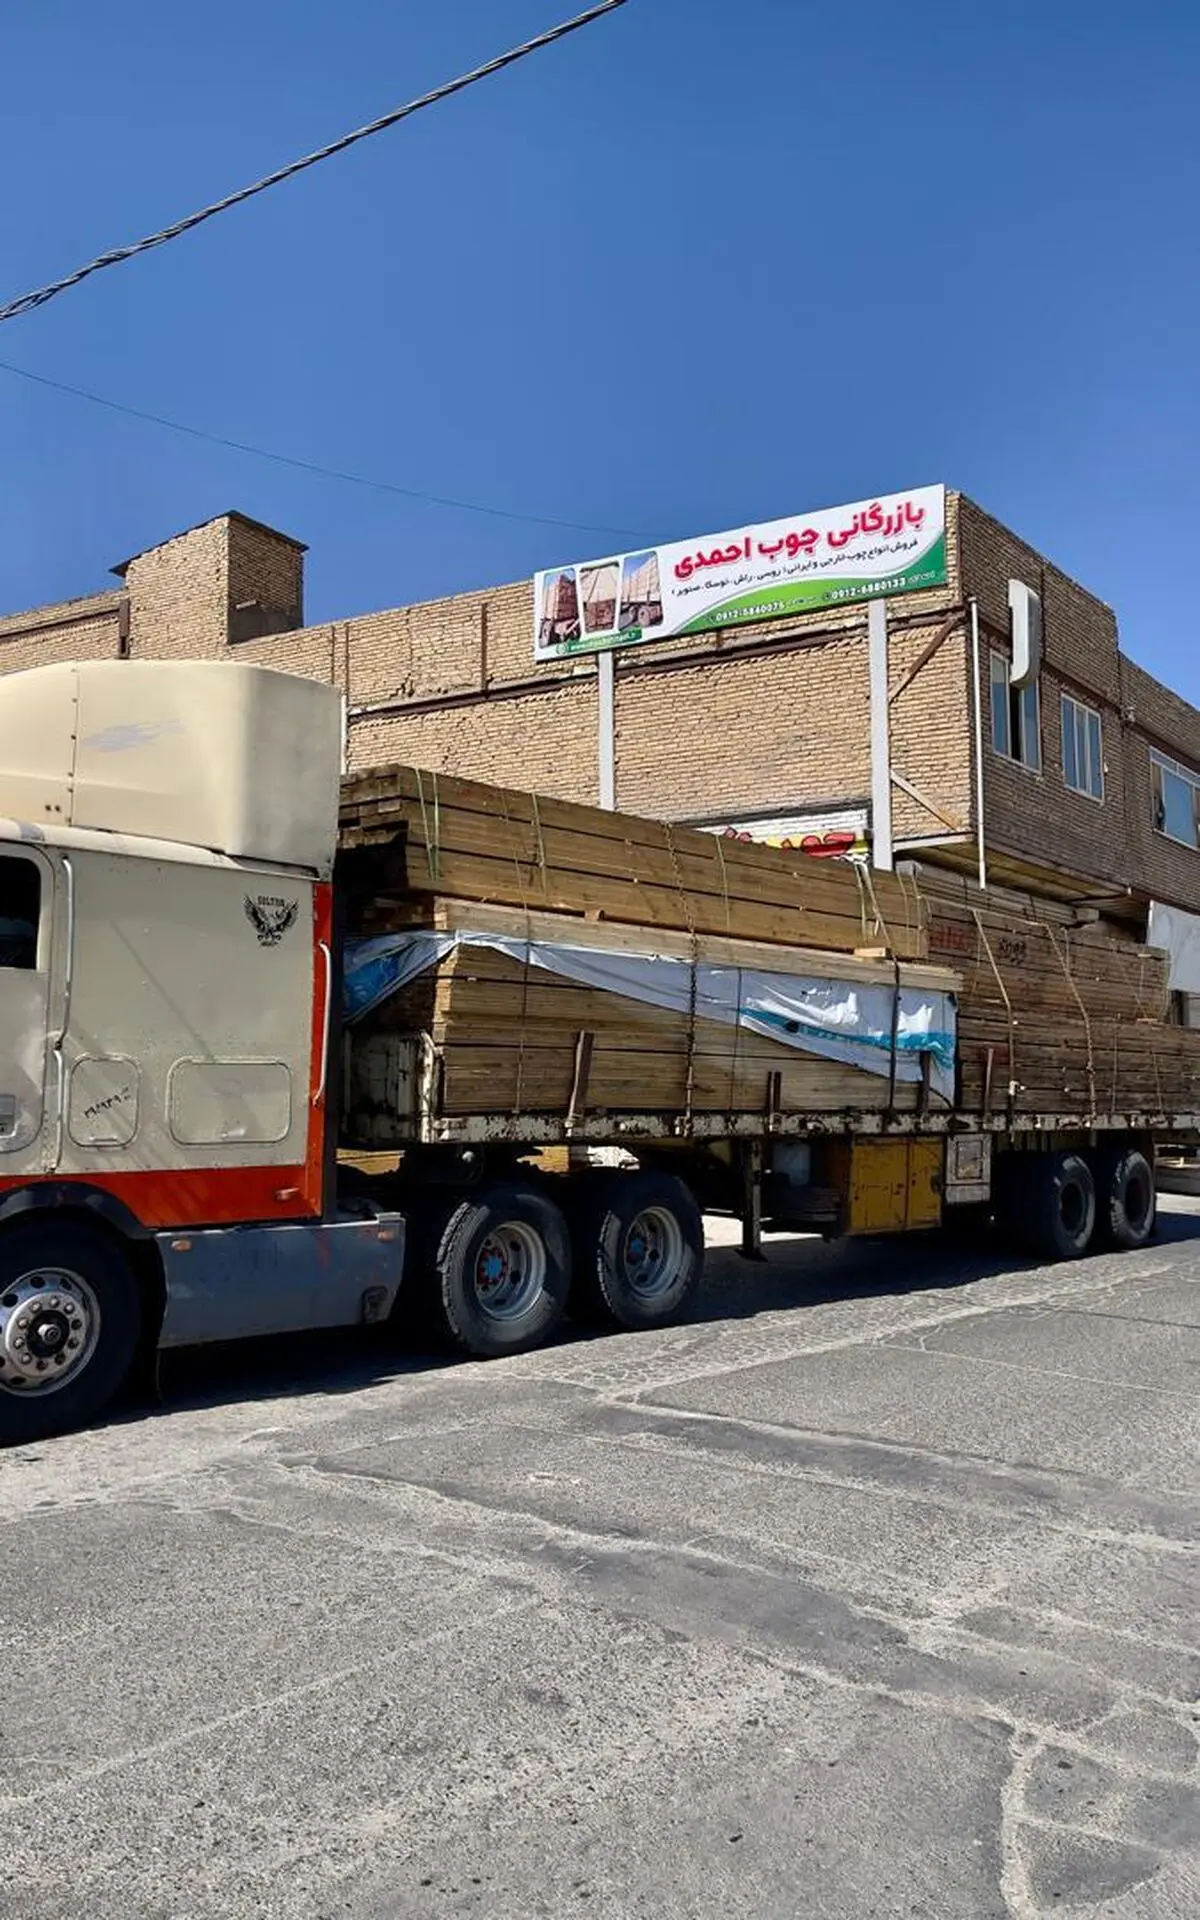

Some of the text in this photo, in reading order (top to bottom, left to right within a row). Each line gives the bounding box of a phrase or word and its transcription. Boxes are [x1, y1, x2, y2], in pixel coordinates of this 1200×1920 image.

[673, 501, 925, 579] بازرگانی چوب احمدی
[890, 538, 918, 553] فروش
[846, 550, 867, 561] چوب
[867, 544, 889, 559] انواع
[819, 553, 846, 568] خارجی
